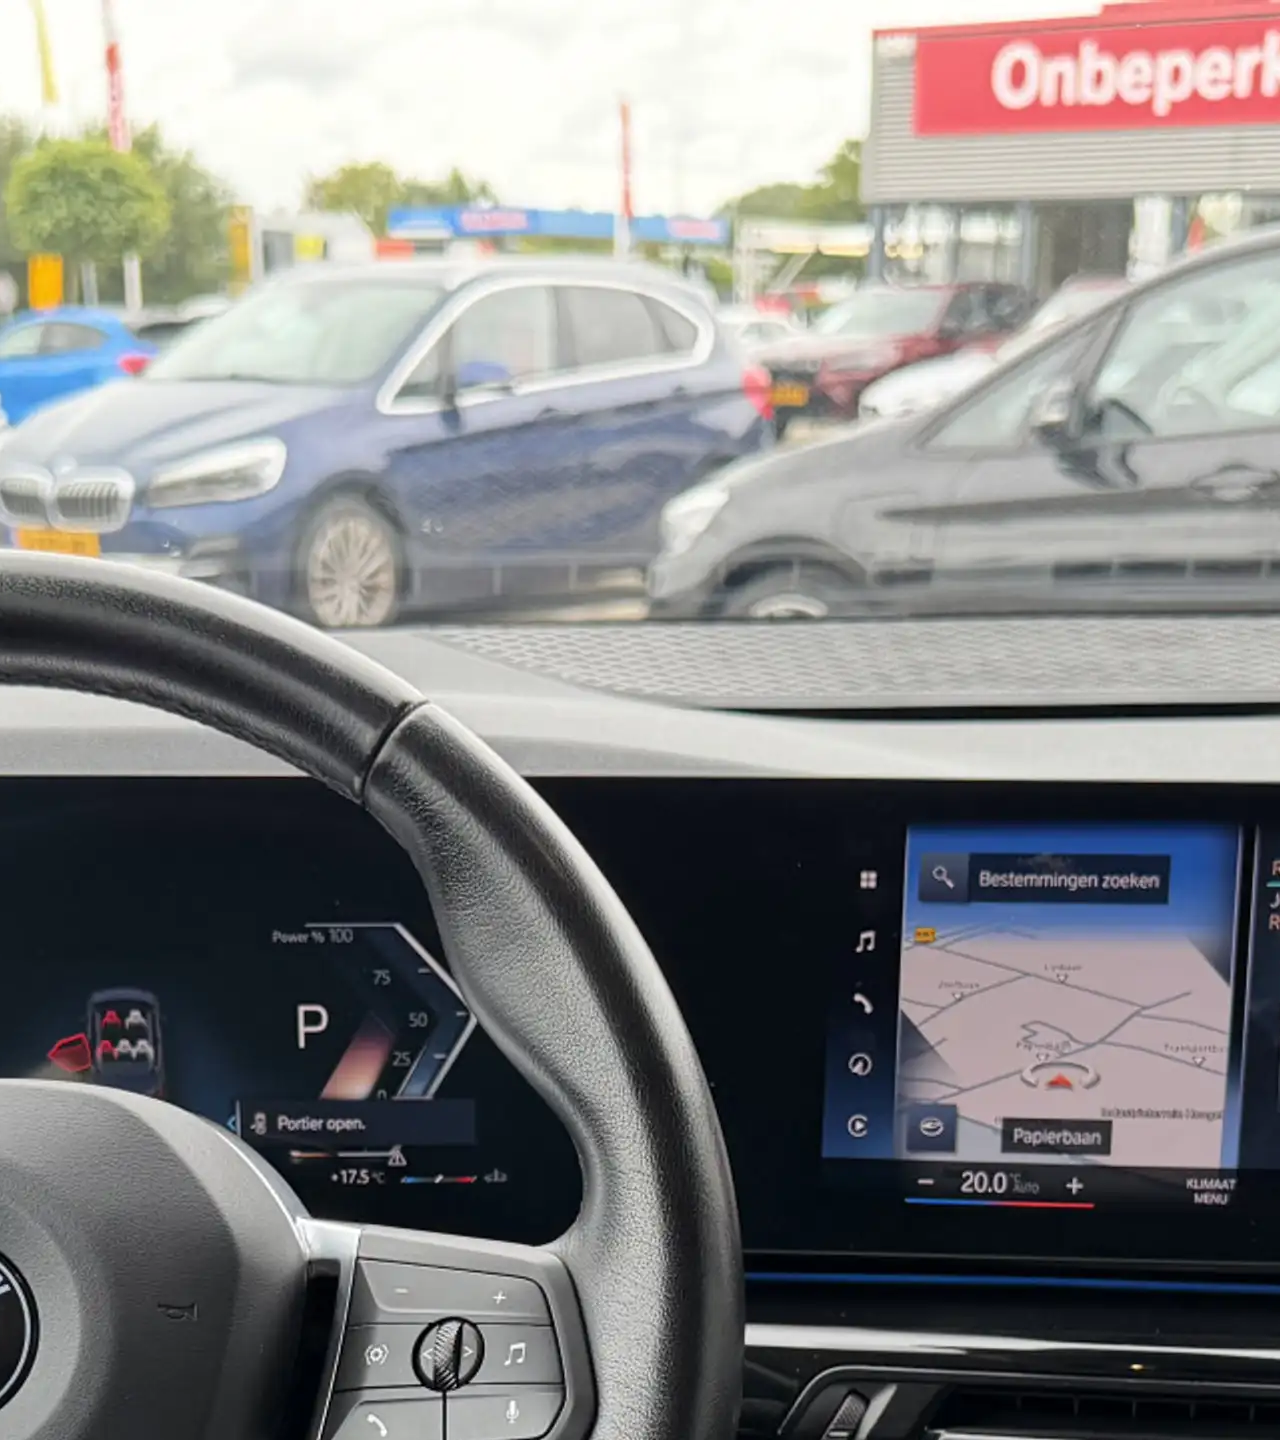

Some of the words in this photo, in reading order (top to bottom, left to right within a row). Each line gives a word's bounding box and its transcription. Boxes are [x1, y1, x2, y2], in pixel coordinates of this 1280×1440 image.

[979, 869, 1099, 891] Bestemmingen
[1102, 872, 1160, 889] zoeken
[272, 931, 308, 943] Power
[328, 928, 353, 943] 100
[373, 969, 391, 985] 75
[297, 1003, 329, 1049] P
[408, 1012, 428, 1028] 50
[392, 1051, 410, 1067] 25
[277, 1113, 324, 1130] Portier
[326, 1117, 366, 1131] open.
[1013, 1128, 1102, 1146] Papierbaan
[960, 1171, 1008, 1194] 20.0
[1186, 1178, 1237, 1190] KLIMAAT
[1194, 1192, 1229, 1205] MENU
